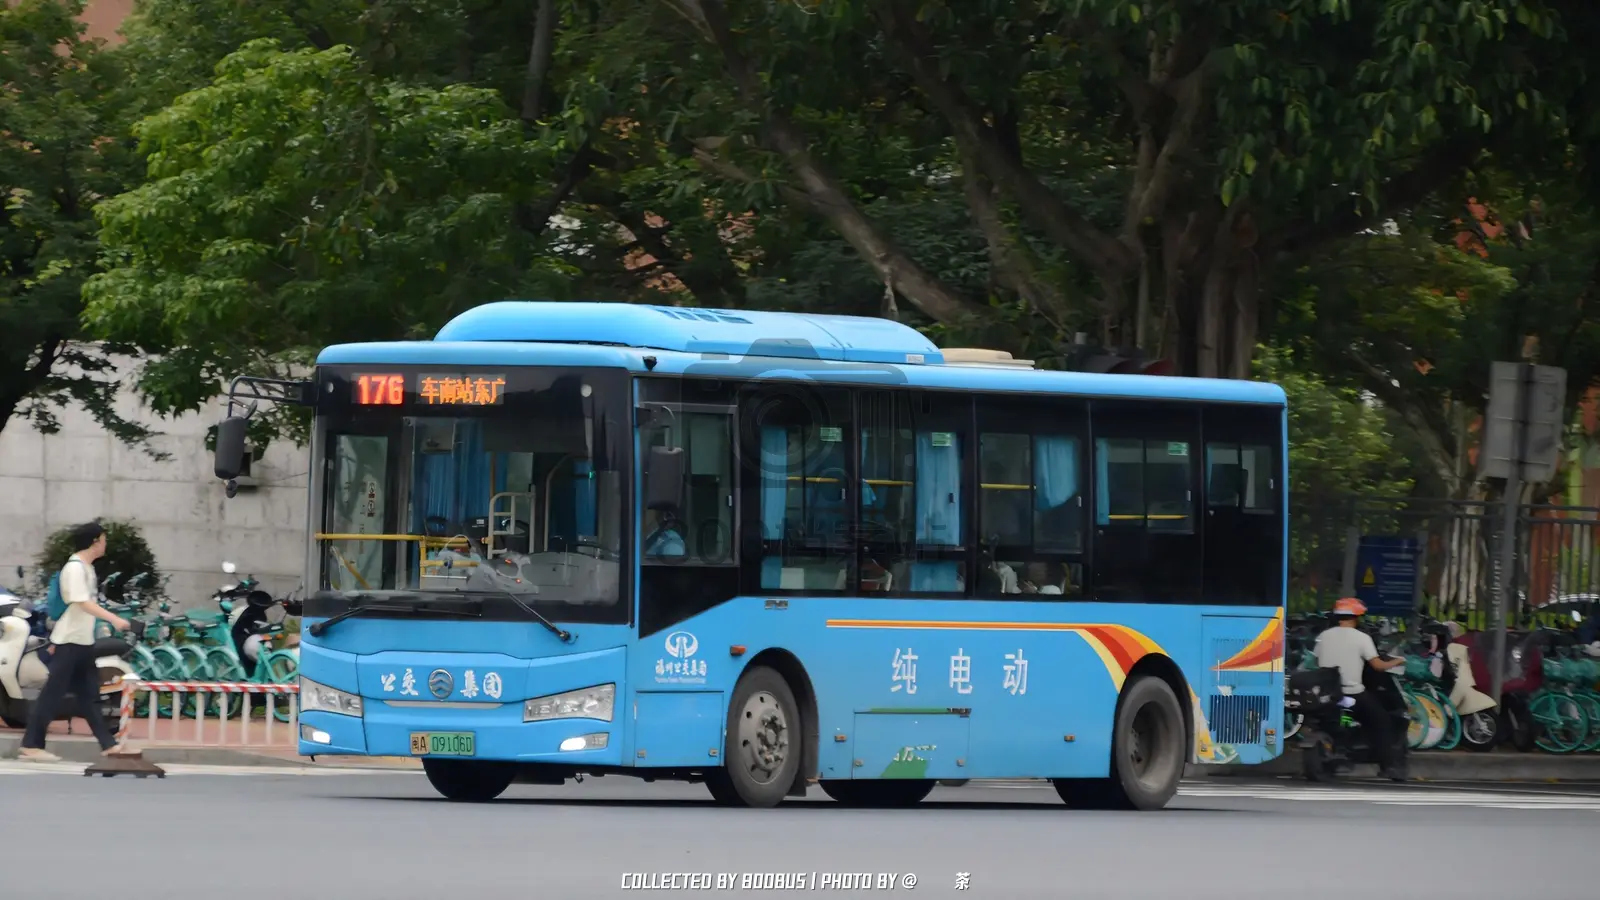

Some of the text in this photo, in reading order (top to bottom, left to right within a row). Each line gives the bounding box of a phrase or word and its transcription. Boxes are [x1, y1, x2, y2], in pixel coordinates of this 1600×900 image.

[358, 375, 404, 405] 176
[381, 668, 502, 699] 公交 集团
[890, 648, 1029, 695] 纯电动
